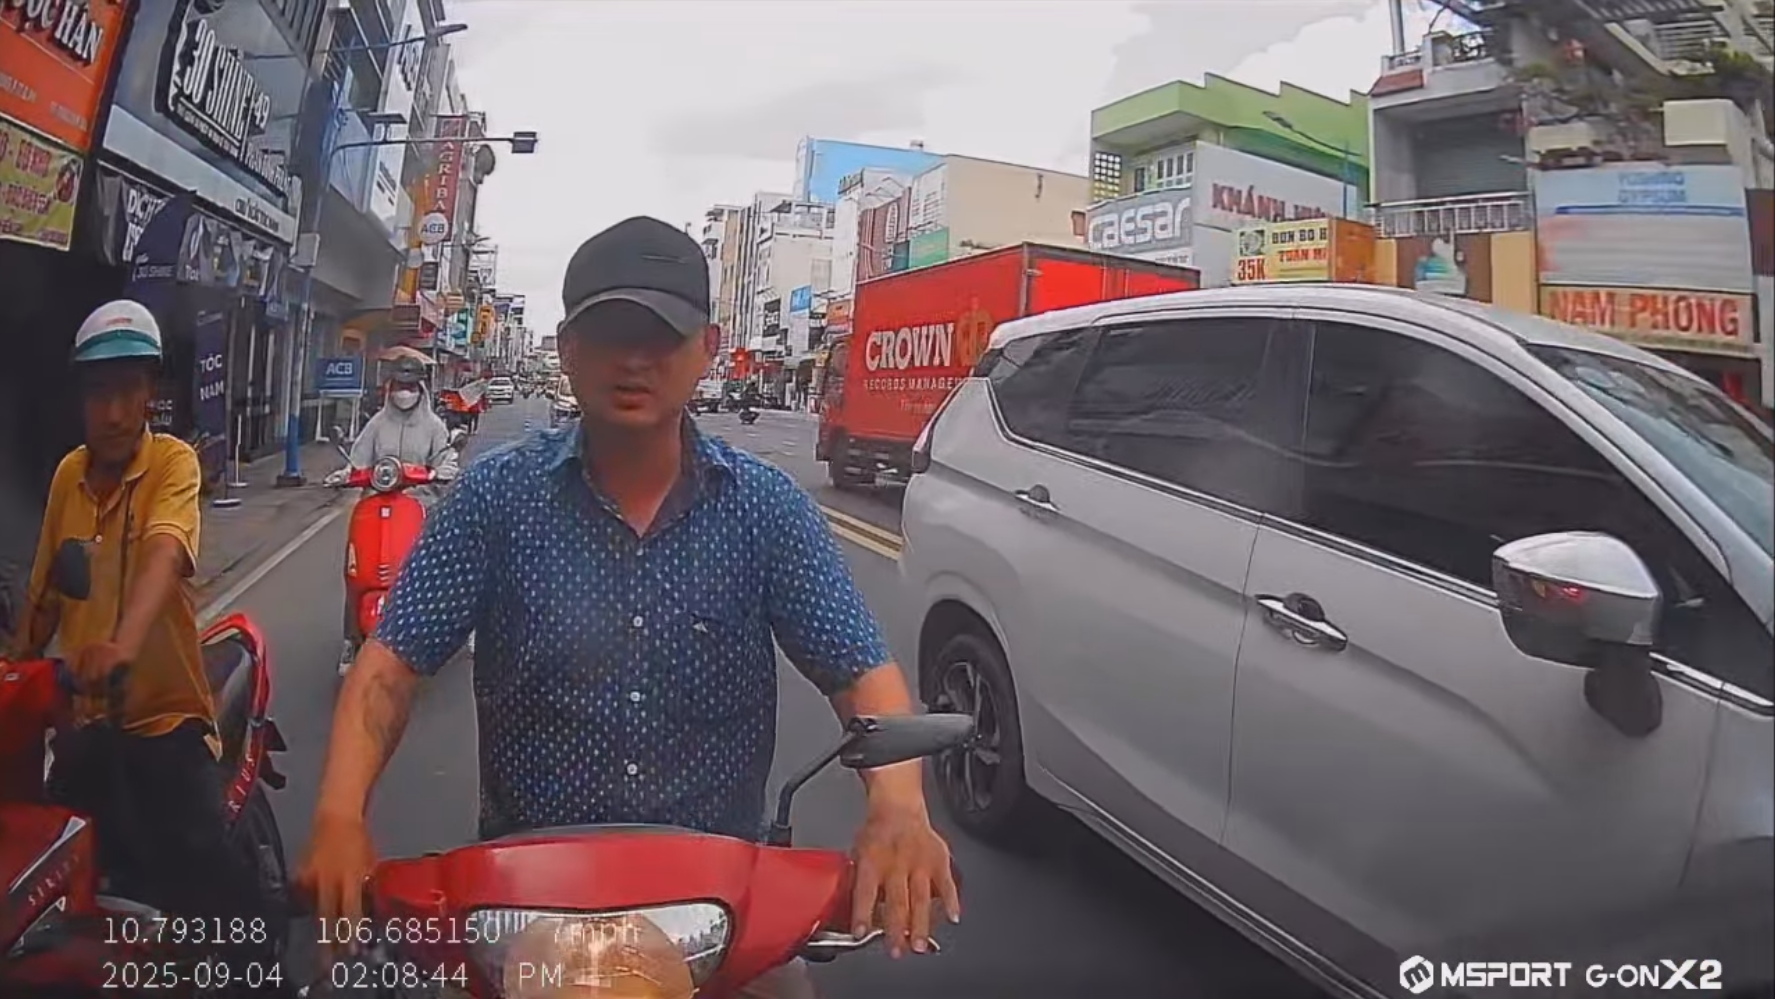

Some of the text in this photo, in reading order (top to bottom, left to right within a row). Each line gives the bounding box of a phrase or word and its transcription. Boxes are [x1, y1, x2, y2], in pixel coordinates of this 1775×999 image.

[184, 19, 215, 104] 30
[205, 44, 254, 140] SHINE
[254, 92, 270, 129] 49
[435, 140, 454, 210] AGRIBA
[1088, 198, 1191, 248] caesar
[1212, 183, 1285, 222] KHÁNH
[421, 222, 445, 235] ACB
[1238, 258, 1266, 280] 35K
[1551, 289, 1739, 336] NAM PHONG
[866, 322, 955, 371] CROWN
[326, 362, 353, 375] ACB
[200, 380, 224, 401] NAM
